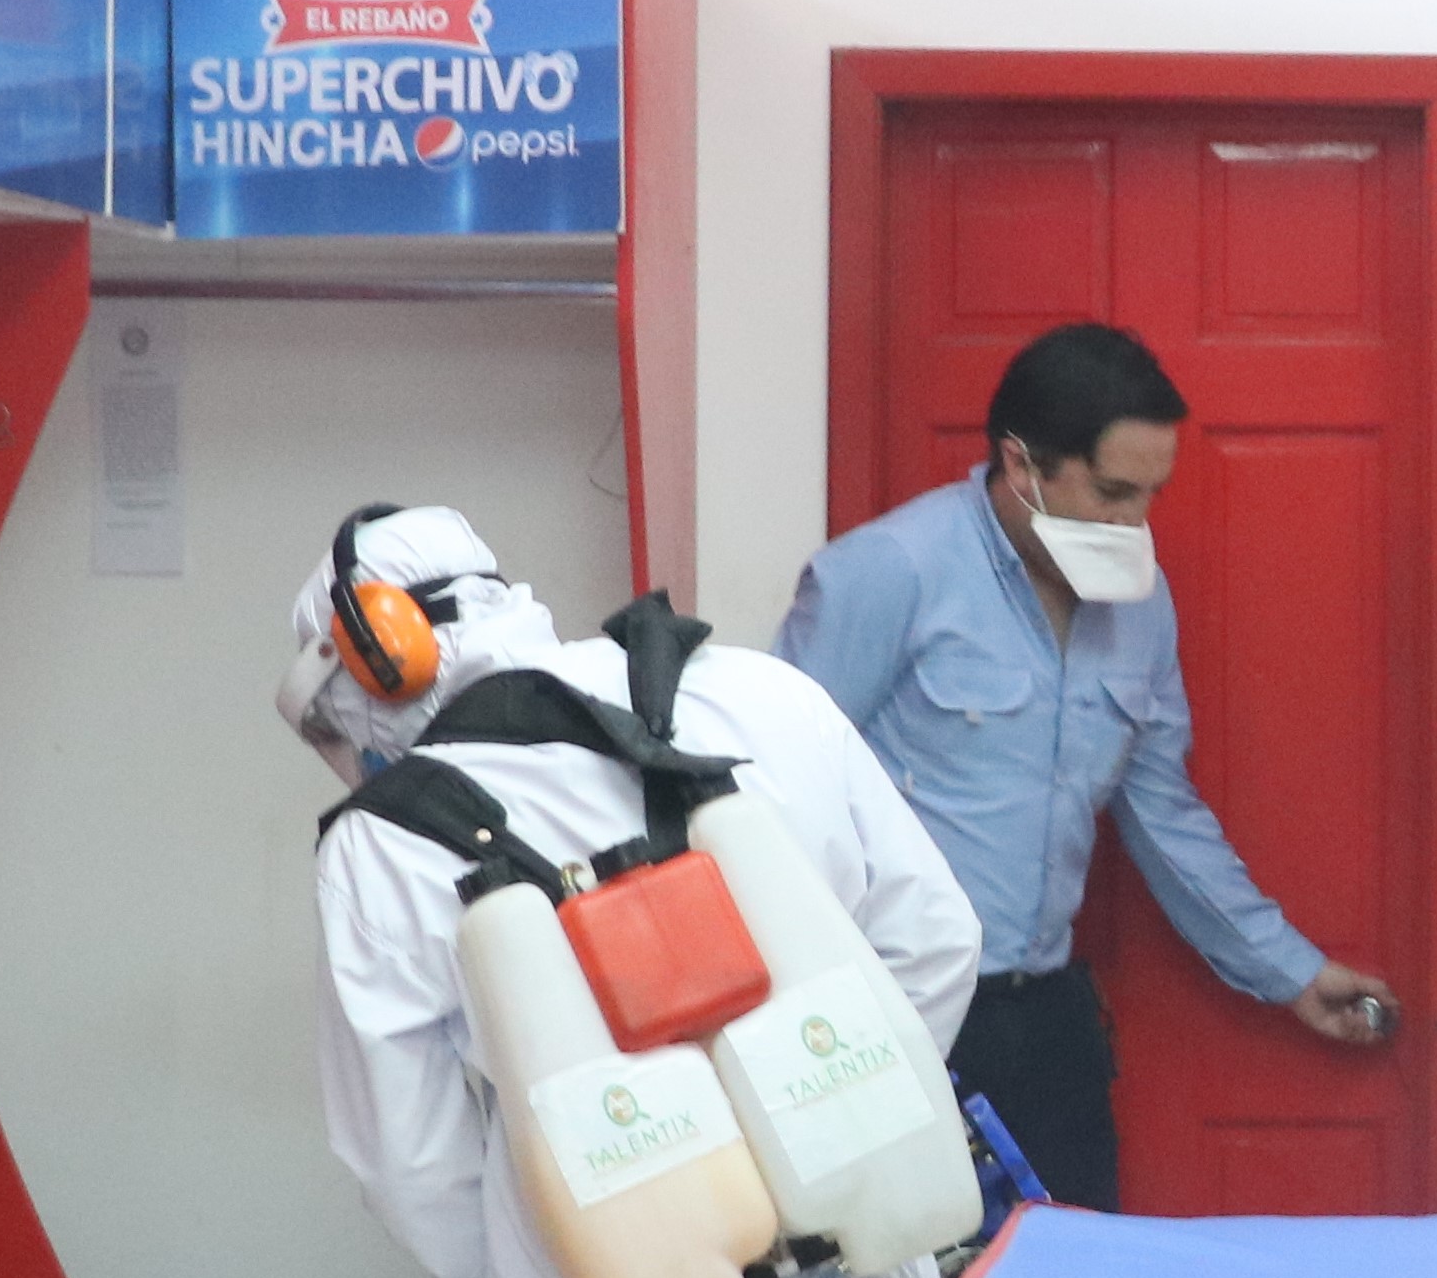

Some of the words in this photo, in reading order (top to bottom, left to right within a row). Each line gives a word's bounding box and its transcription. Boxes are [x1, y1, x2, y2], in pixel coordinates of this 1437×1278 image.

[305, 6, 334, 32] EL
[340, 2, 450, 33] REBAÑO
[190, 53, 578, 113] SUPERCHIVO
[192, 119, 408, 168] HINCHA
[471, 124, 577, 165] pepsi
[784, 1038, 898, 1104] TALENTIX
[583, 1110, 699, 1171] TALENTIX
